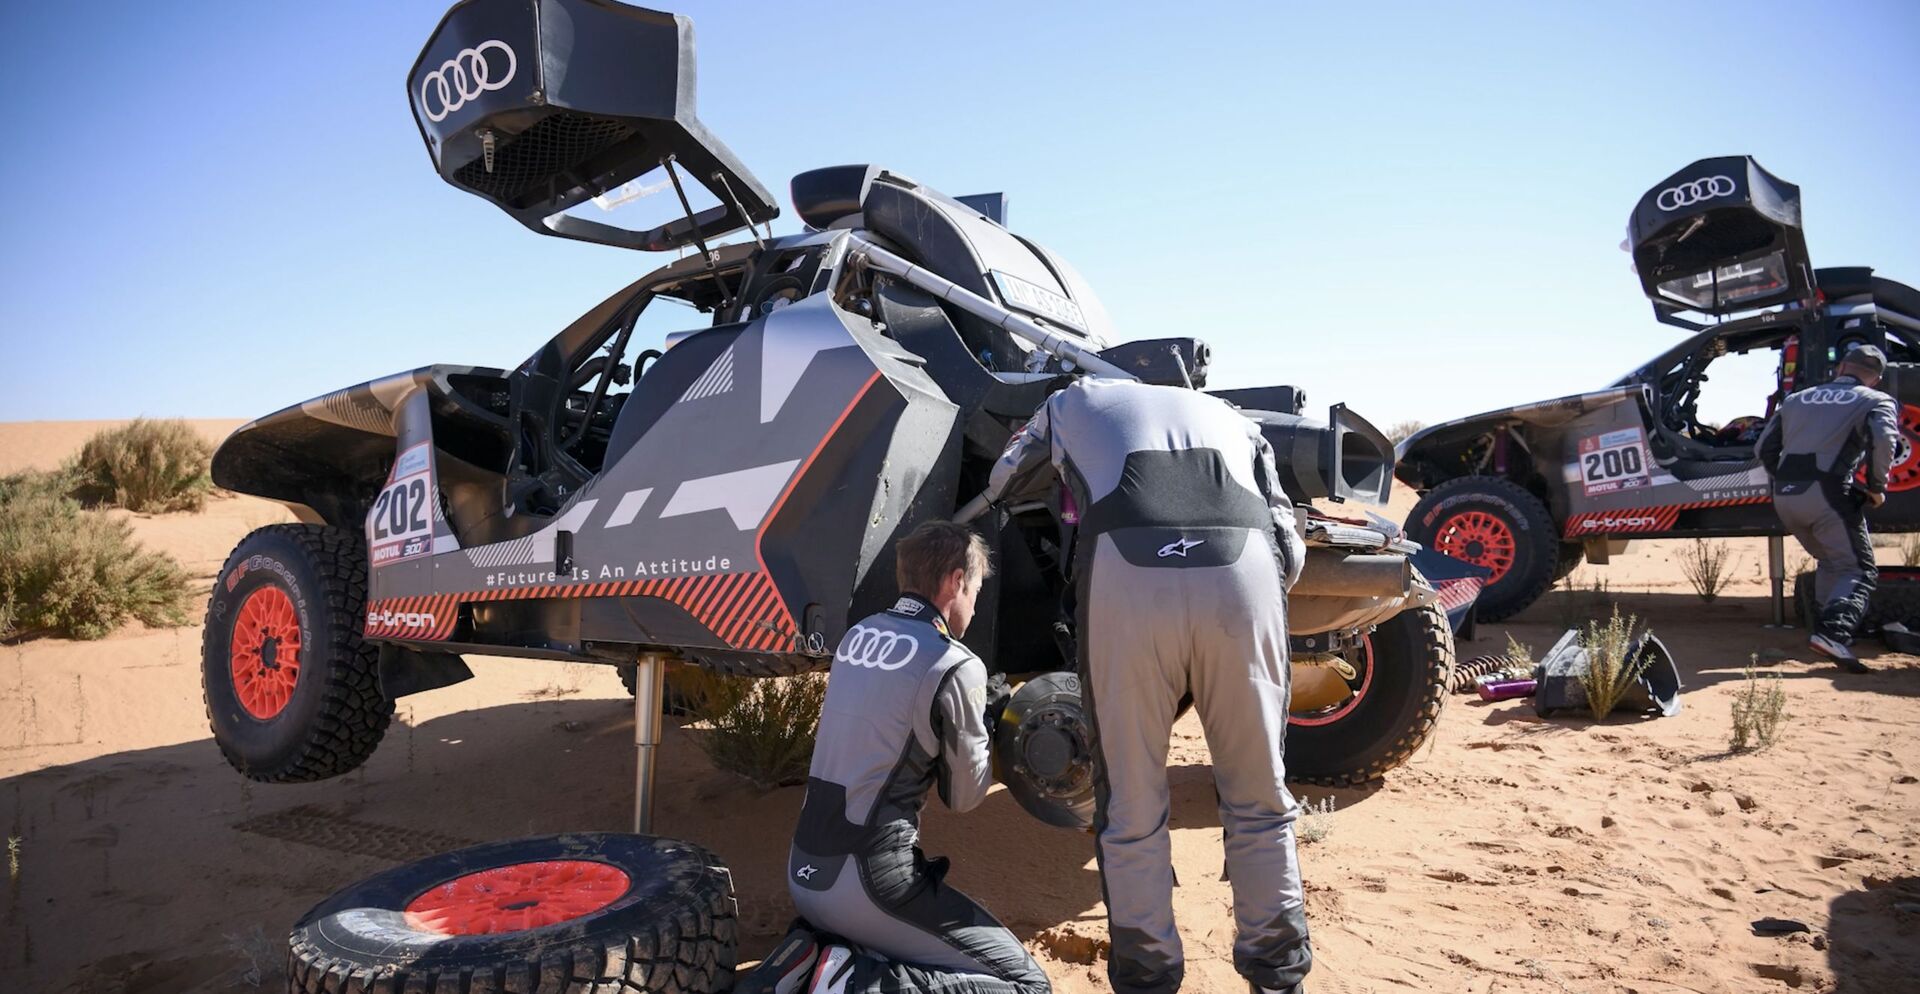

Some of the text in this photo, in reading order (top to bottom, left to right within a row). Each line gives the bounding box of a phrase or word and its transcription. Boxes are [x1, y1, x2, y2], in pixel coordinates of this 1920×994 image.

[1585, 446, 1642, 482] 200
[1588, 482, 1618, 493] MOTUL
[1703, 487, 1767, 500] #Future
[374, 479, 427, 541] 202
[1582, 516, 1656, 529] e-tron
[374, 544, 401, 561] MOTUL
[486, 556, 731, 587] #Future Is An Attitude
[368, 609, 435, 628] e-tron
